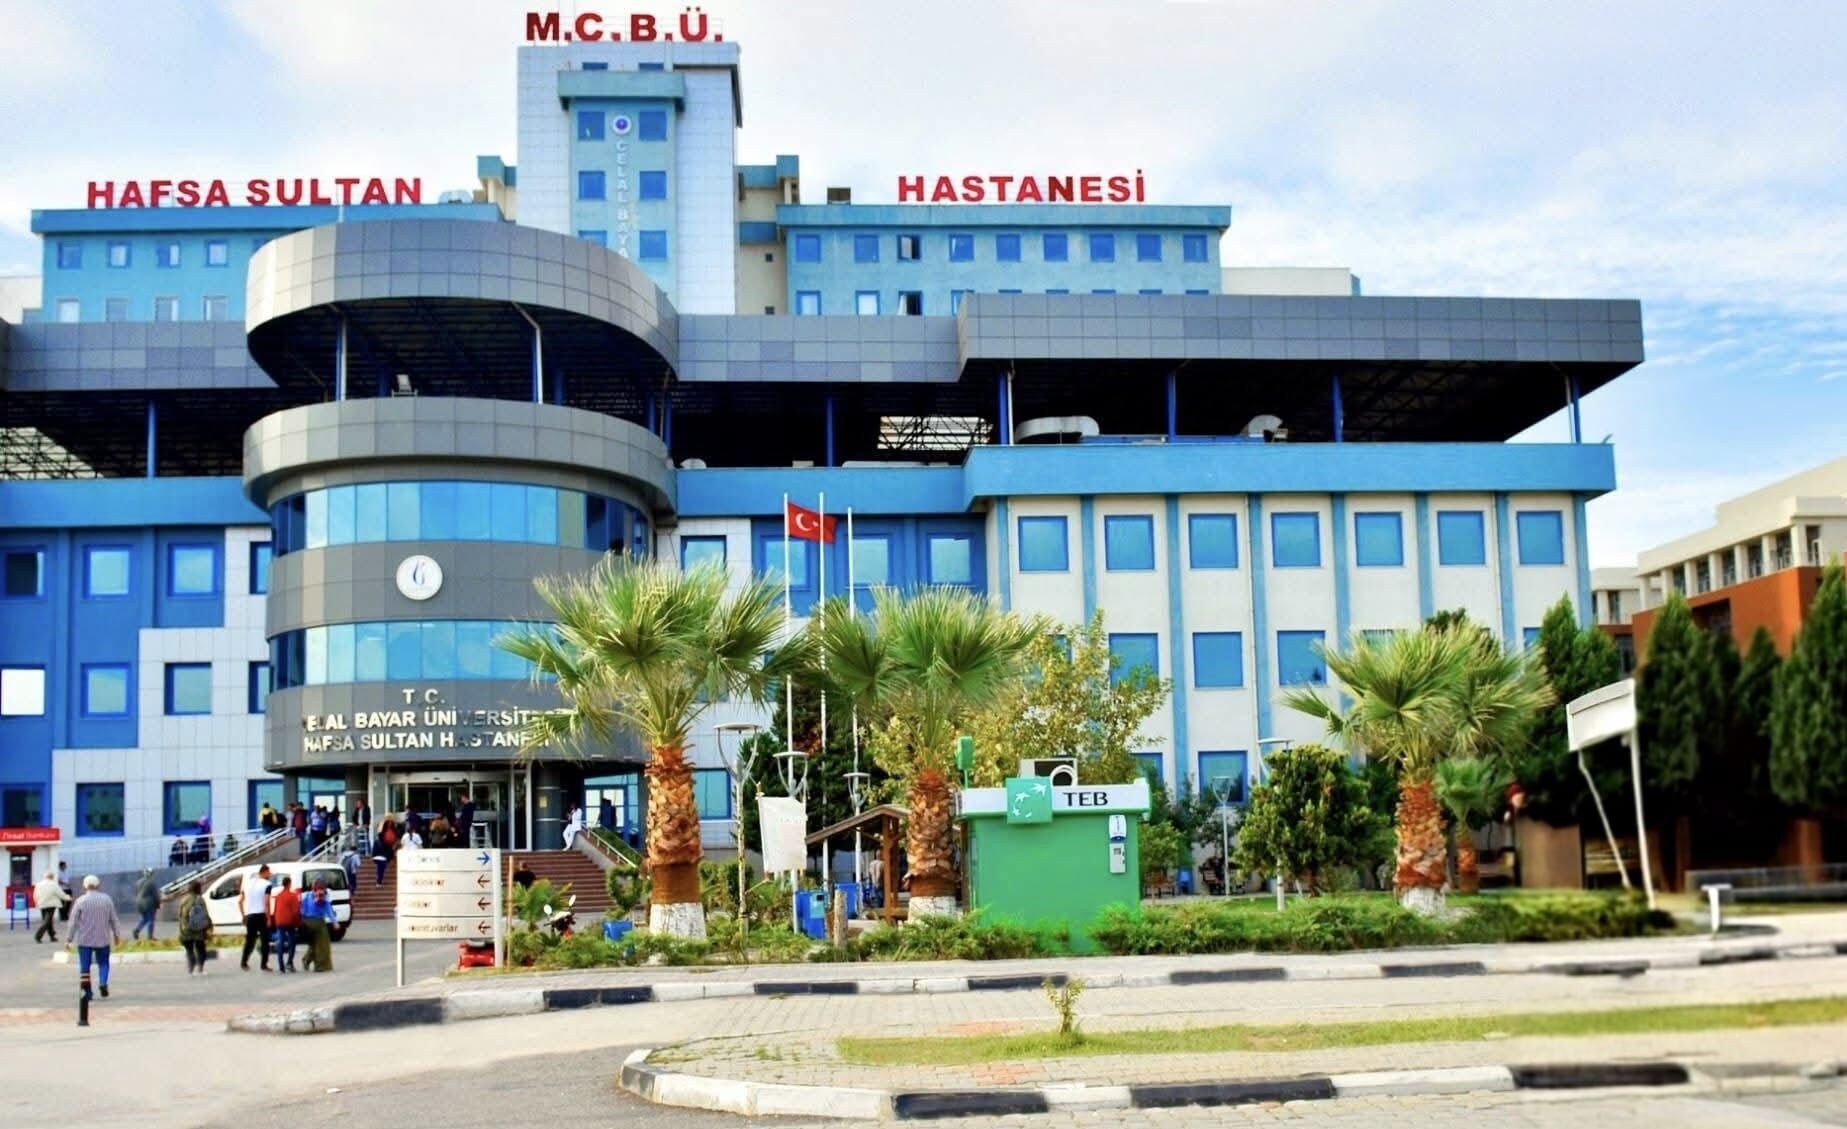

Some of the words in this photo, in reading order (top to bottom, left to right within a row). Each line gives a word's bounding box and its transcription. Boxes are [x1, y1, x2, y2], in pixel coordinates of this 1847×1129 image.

[87, 180, 230, 209] HAFSA
[246, 178, 421, 207] SULTAN
[898, 169, 1145, 202] HASTANESİ
[355, 711, 416, 729] BAYAR
[304, 735, 355, 753] HAFSA
[361, 732, 433, 750] SULTAN
[1062, 791, 1108, 807] TEB
